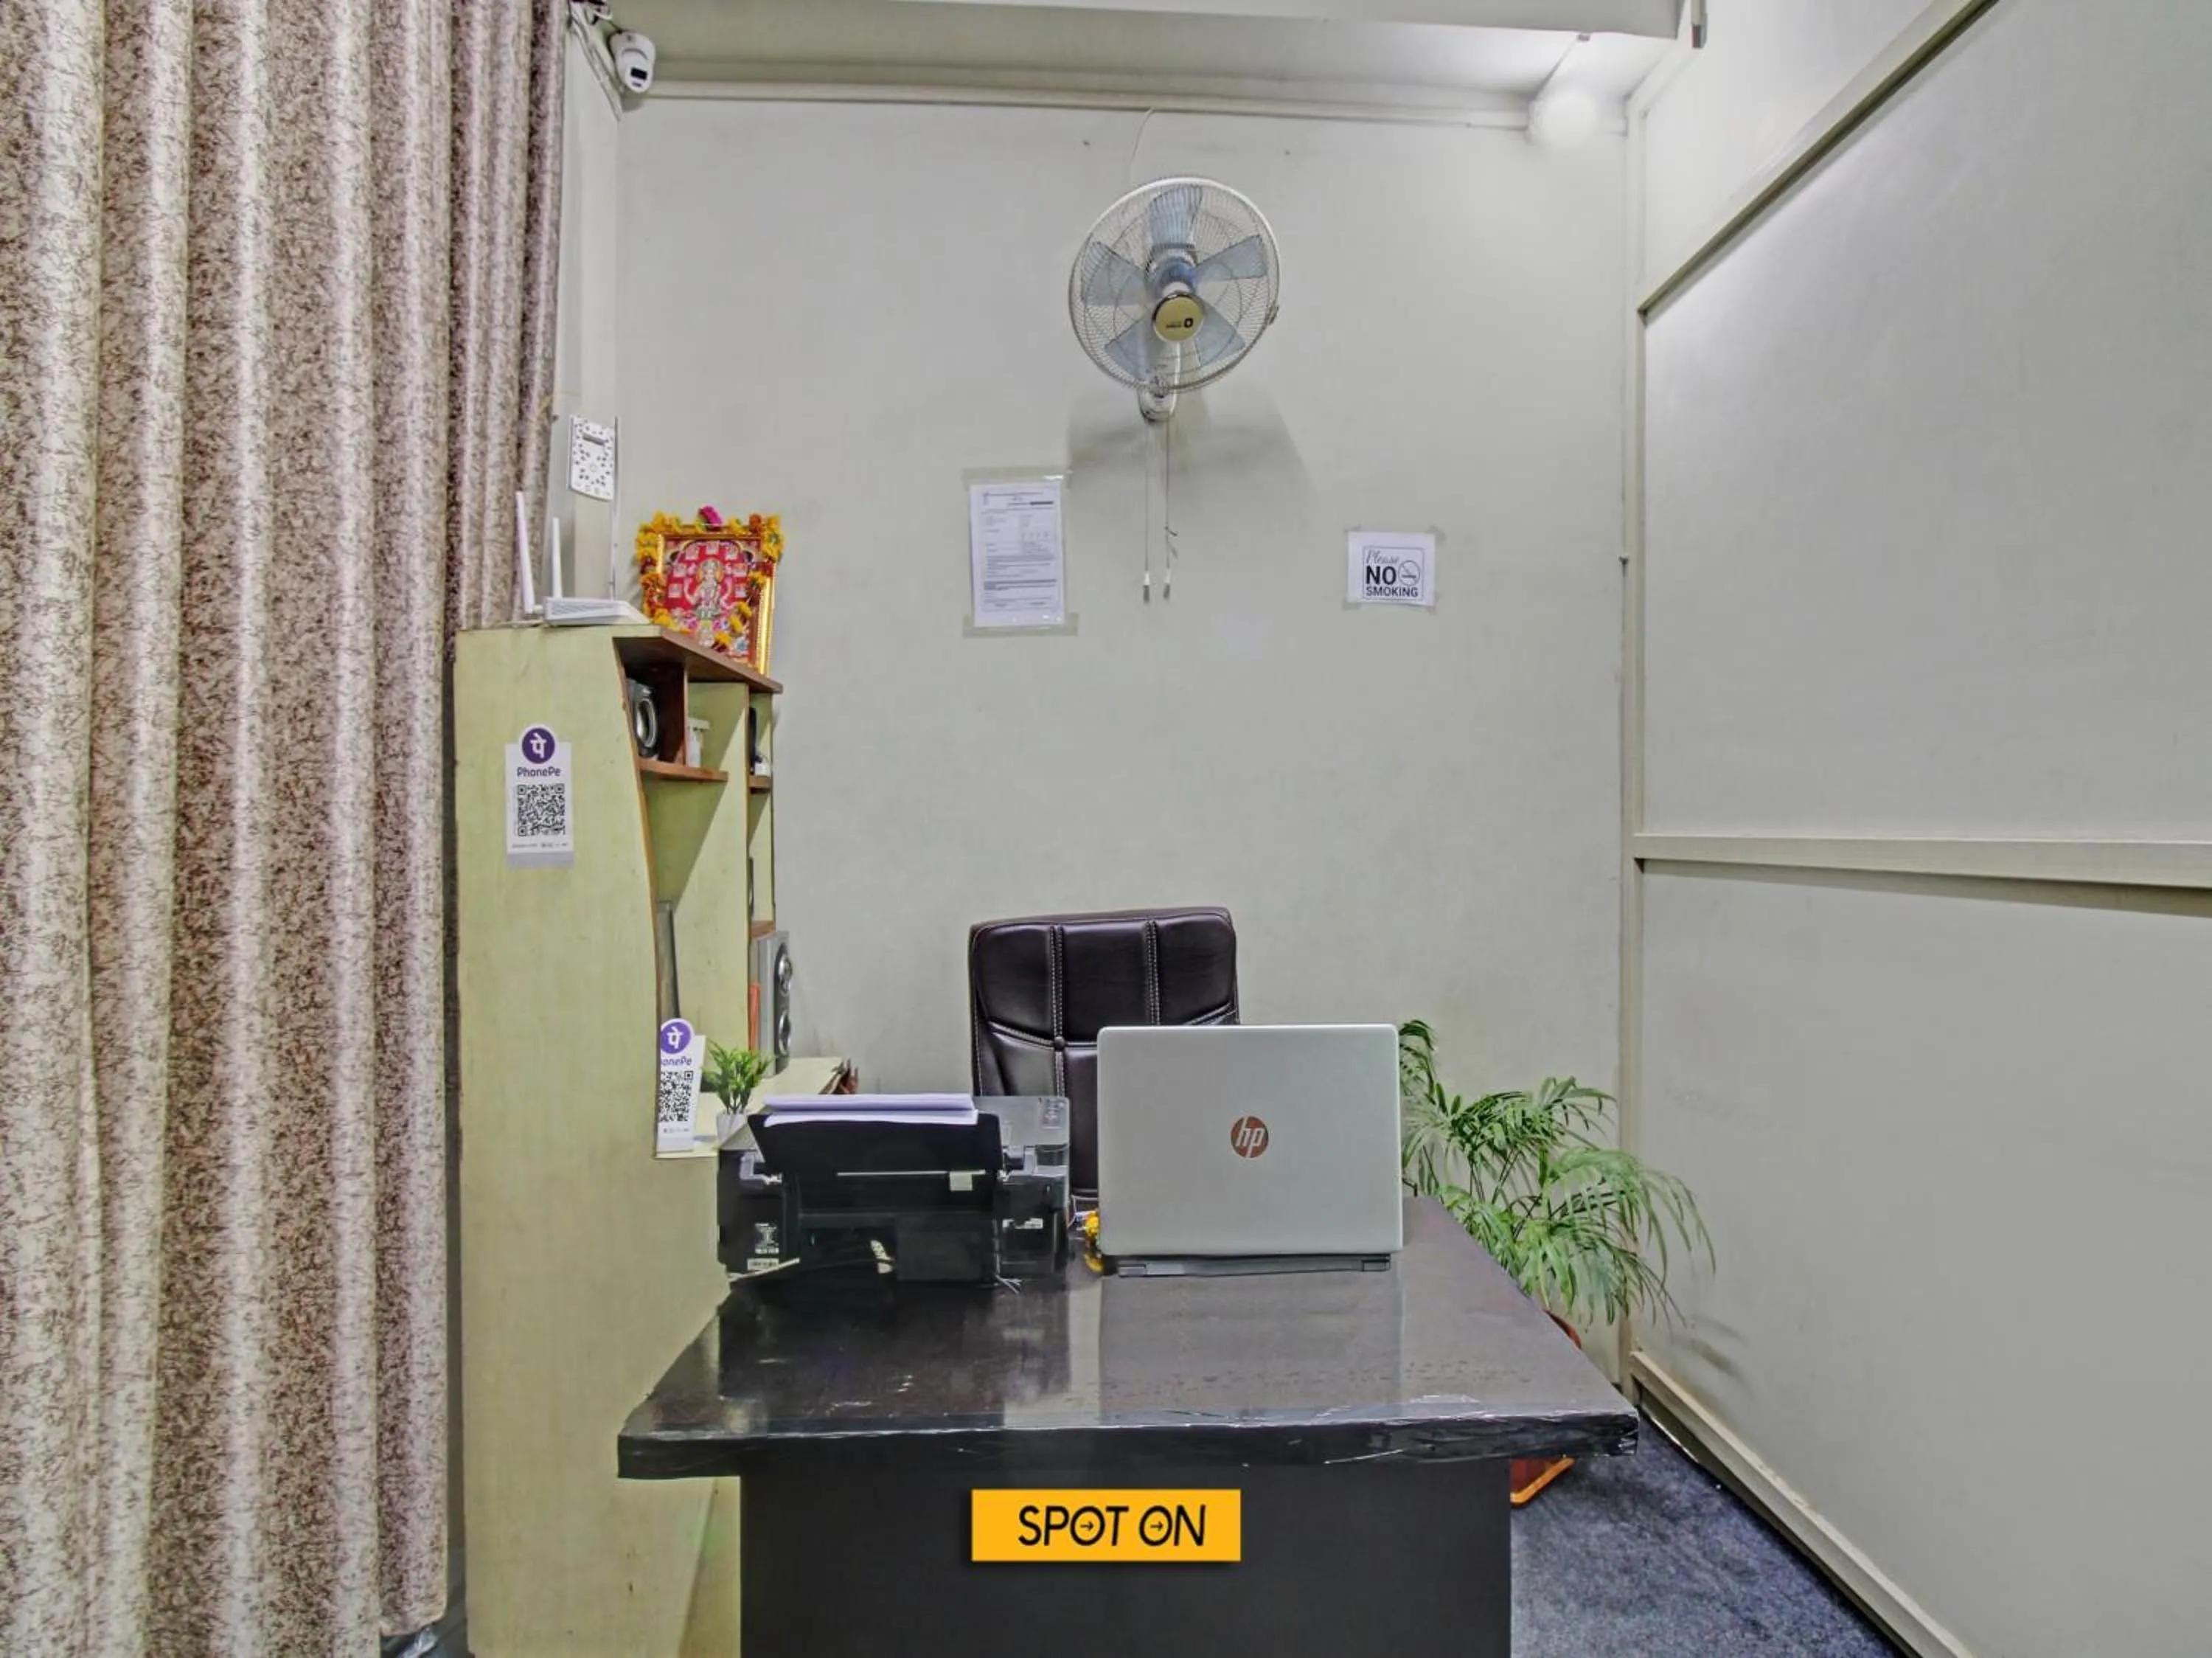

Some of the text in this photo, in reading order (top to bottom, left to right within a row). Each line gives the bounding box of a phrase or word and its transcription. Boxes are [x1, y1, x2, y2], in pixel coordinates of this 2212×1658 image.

[1366, 566, 1397, 585] NO
[1366, 586, 1419, 597] SMOKING
[517, 766, 561, 777] PhonePe
[661, 1055, 692, 1066] onePe
[1235, 1116, 1265, 1159] hp
[1018, 1504, 1206, 1547] SPOT ON
